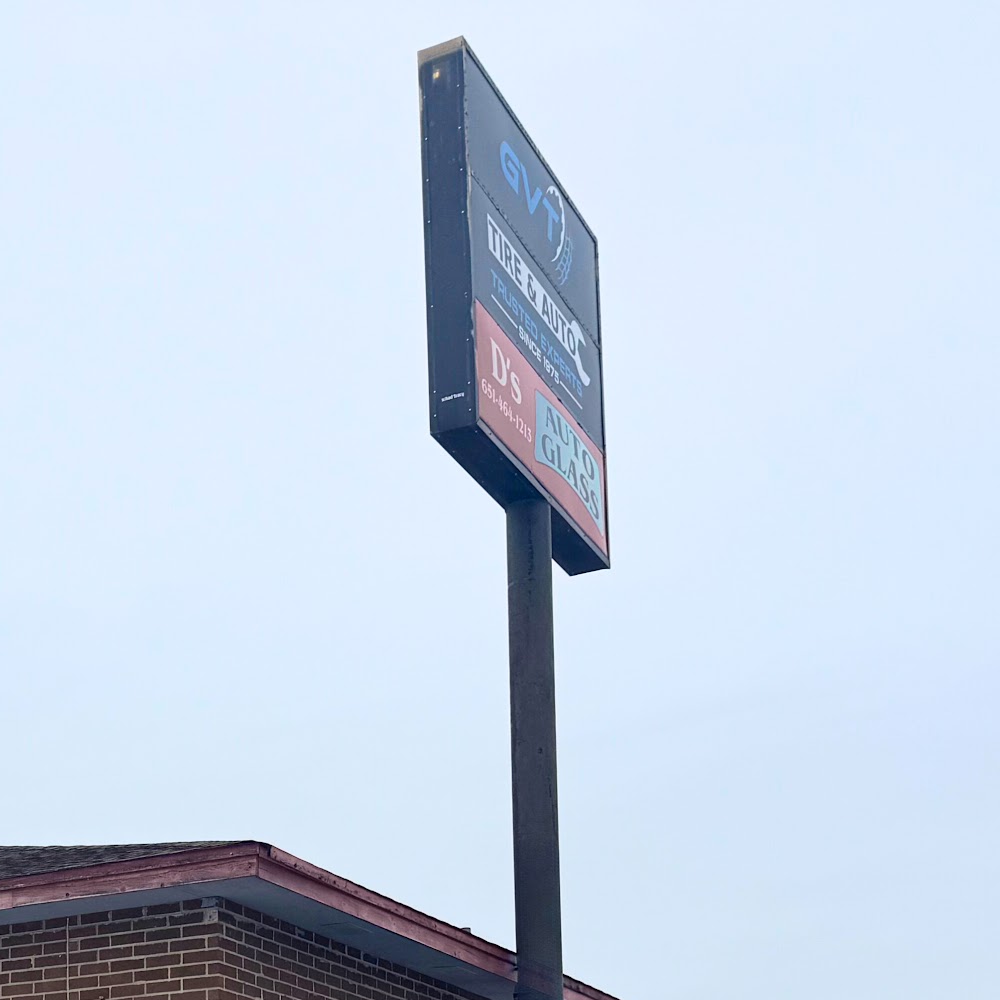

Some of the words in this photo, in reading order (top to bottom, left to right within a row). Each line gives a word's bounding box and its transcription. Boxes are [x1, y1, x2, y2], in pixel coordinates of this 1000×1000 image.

[500, 140, 559, 242] GVT
[488, 218, 522, 288] TIRE
[527, 273, 537, 308] &
[541, 292, 576, 357] AUTO
[490, 268, 538, 341] TRUSTED
[540, 332, 582, 398] EXPERTS
[518, 325, 542, 362] SINCE
[543, 356, 560, 385] 1975
[541, 433, 600, 520] GLASS
[545, 405, 595, 481] AUTO
